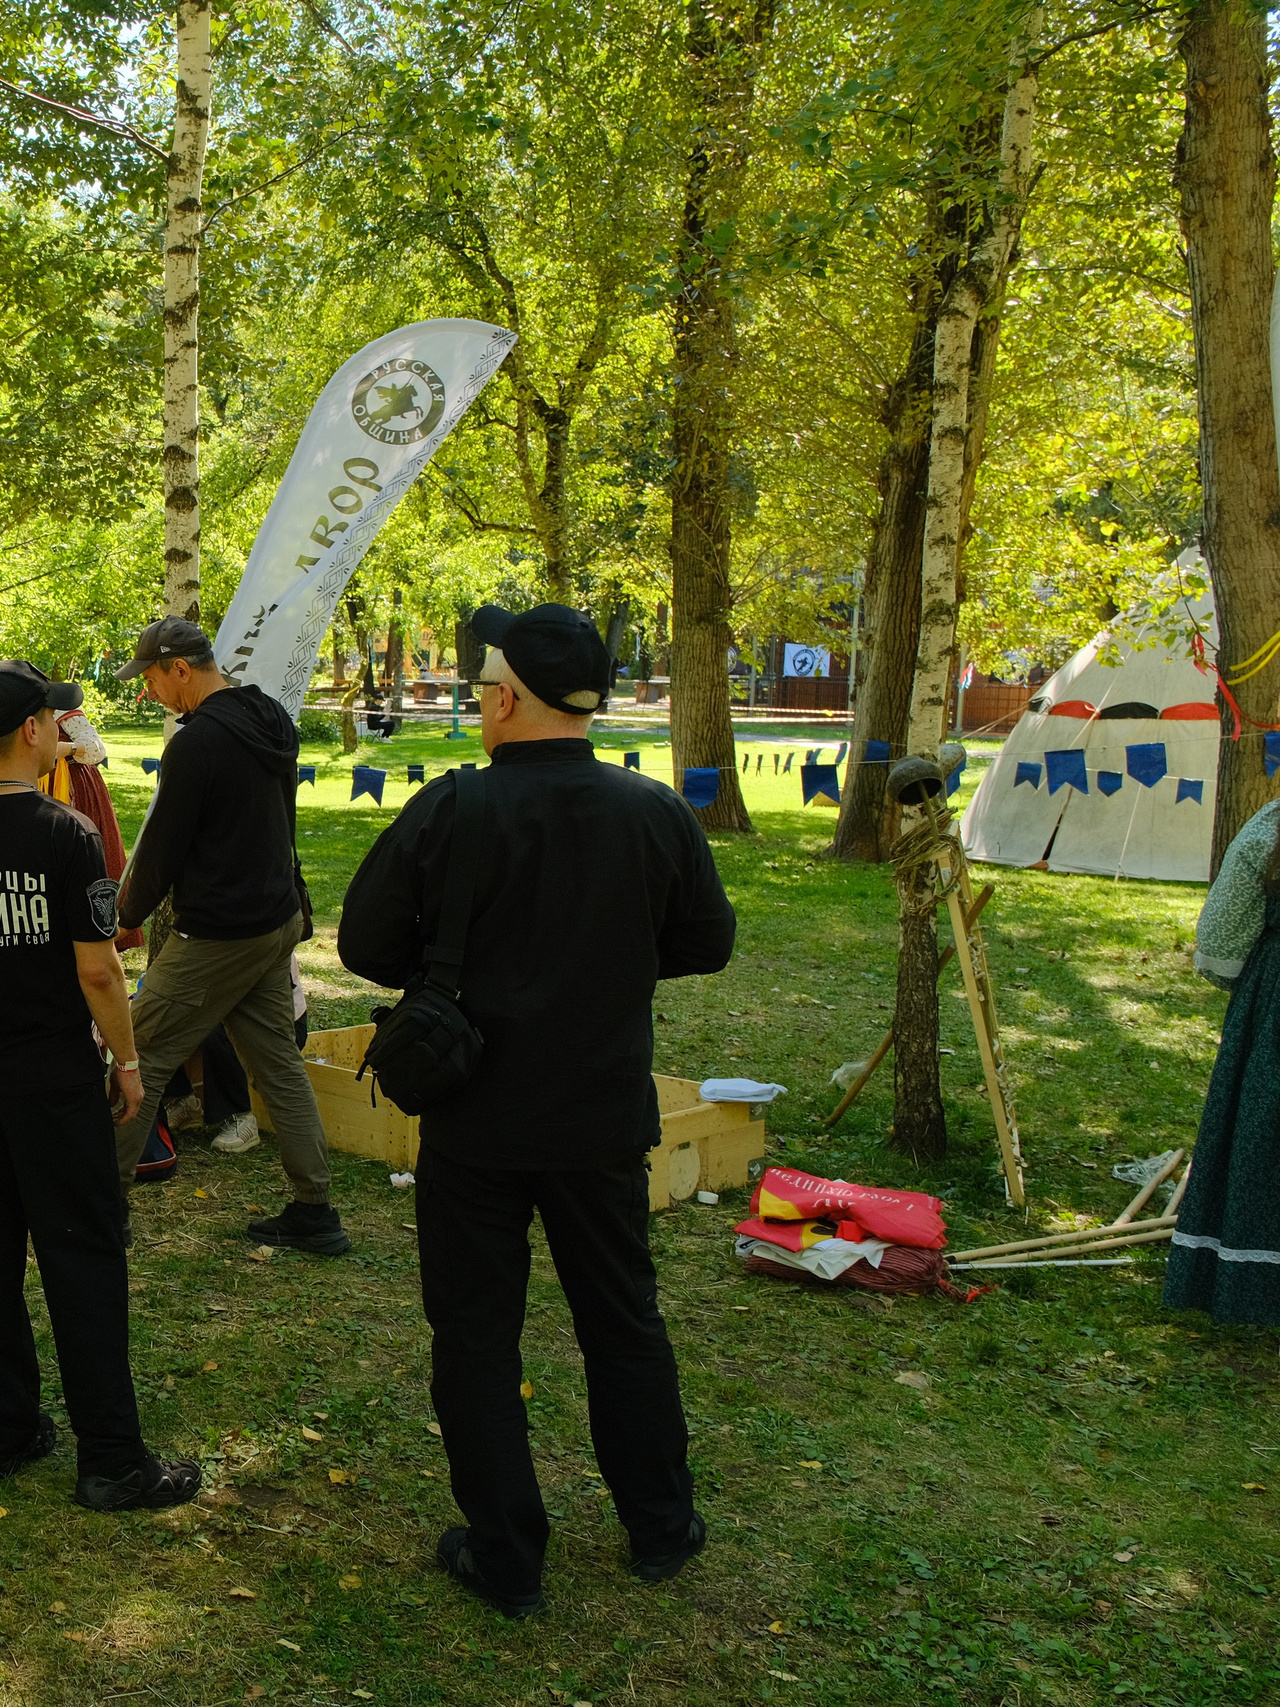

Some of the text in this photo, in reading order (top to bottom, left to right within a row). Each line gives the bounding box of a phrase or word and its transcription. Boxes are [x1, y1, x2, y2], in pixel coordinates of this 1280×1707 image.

[371, 360, 445, 402] РУССКАЯ
[353, 405, 423, 443] ОБЩИНА
[25, 932, 50, 946] СВОЯ
